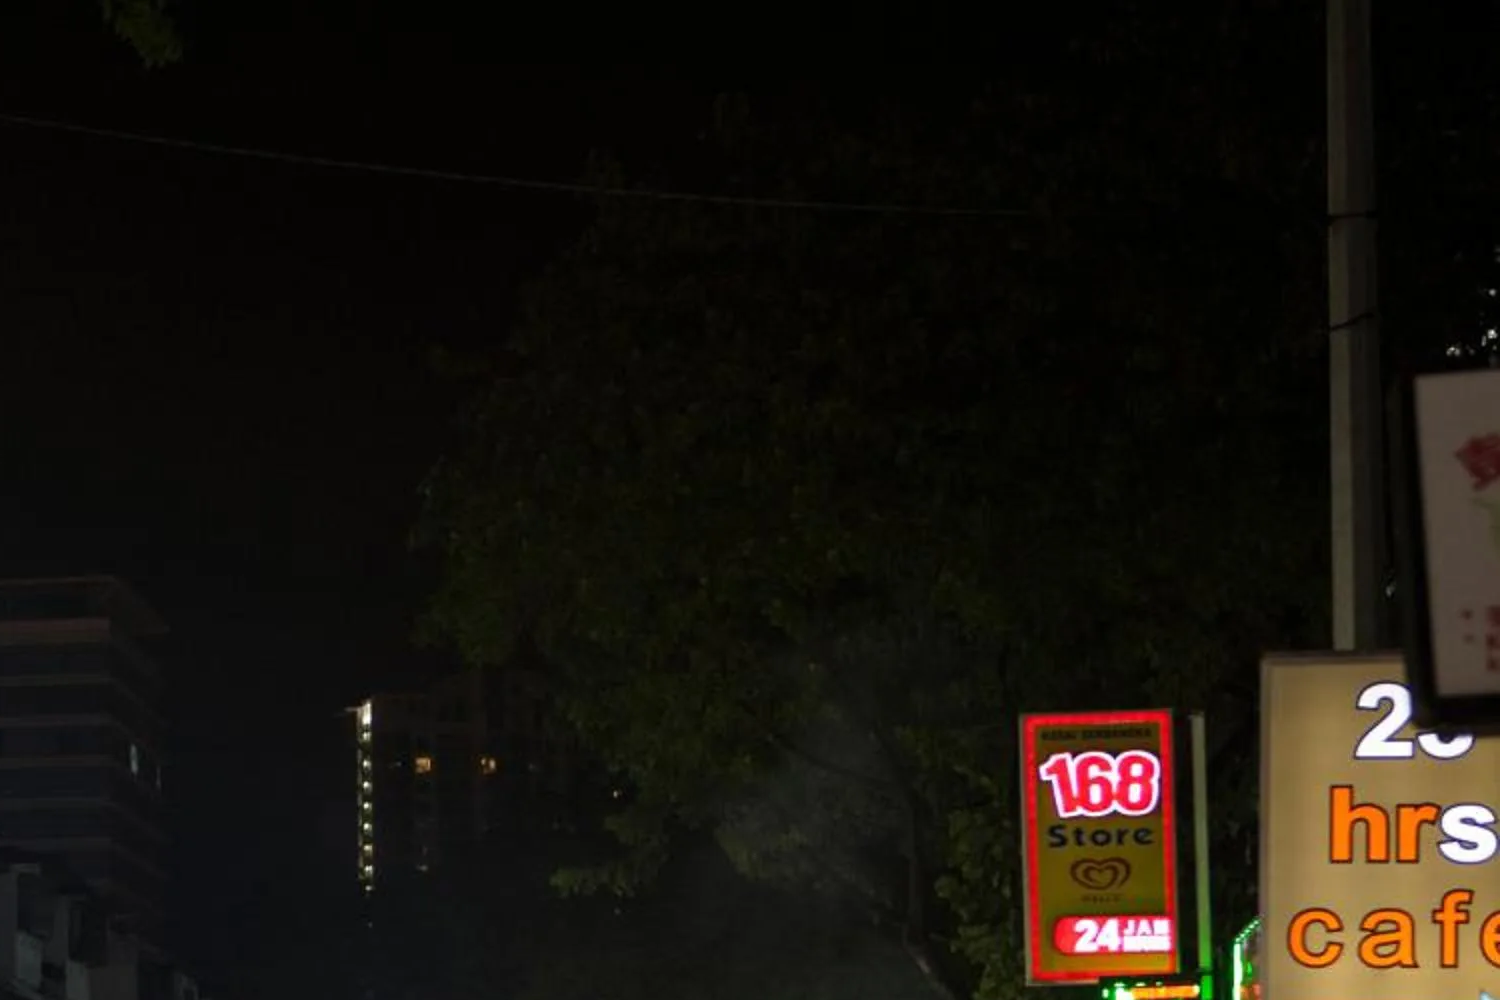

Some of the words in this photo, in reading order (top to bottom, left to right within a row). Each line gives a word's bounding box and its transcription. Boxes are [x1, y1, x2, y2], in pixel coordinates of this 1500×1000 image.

[1040, 750, 1161, 818] 168
[1048, 824, 1156, 848] Store
[1329, 784, 1499, 864] hrs
[1074, 919, 1119, 952] 24
